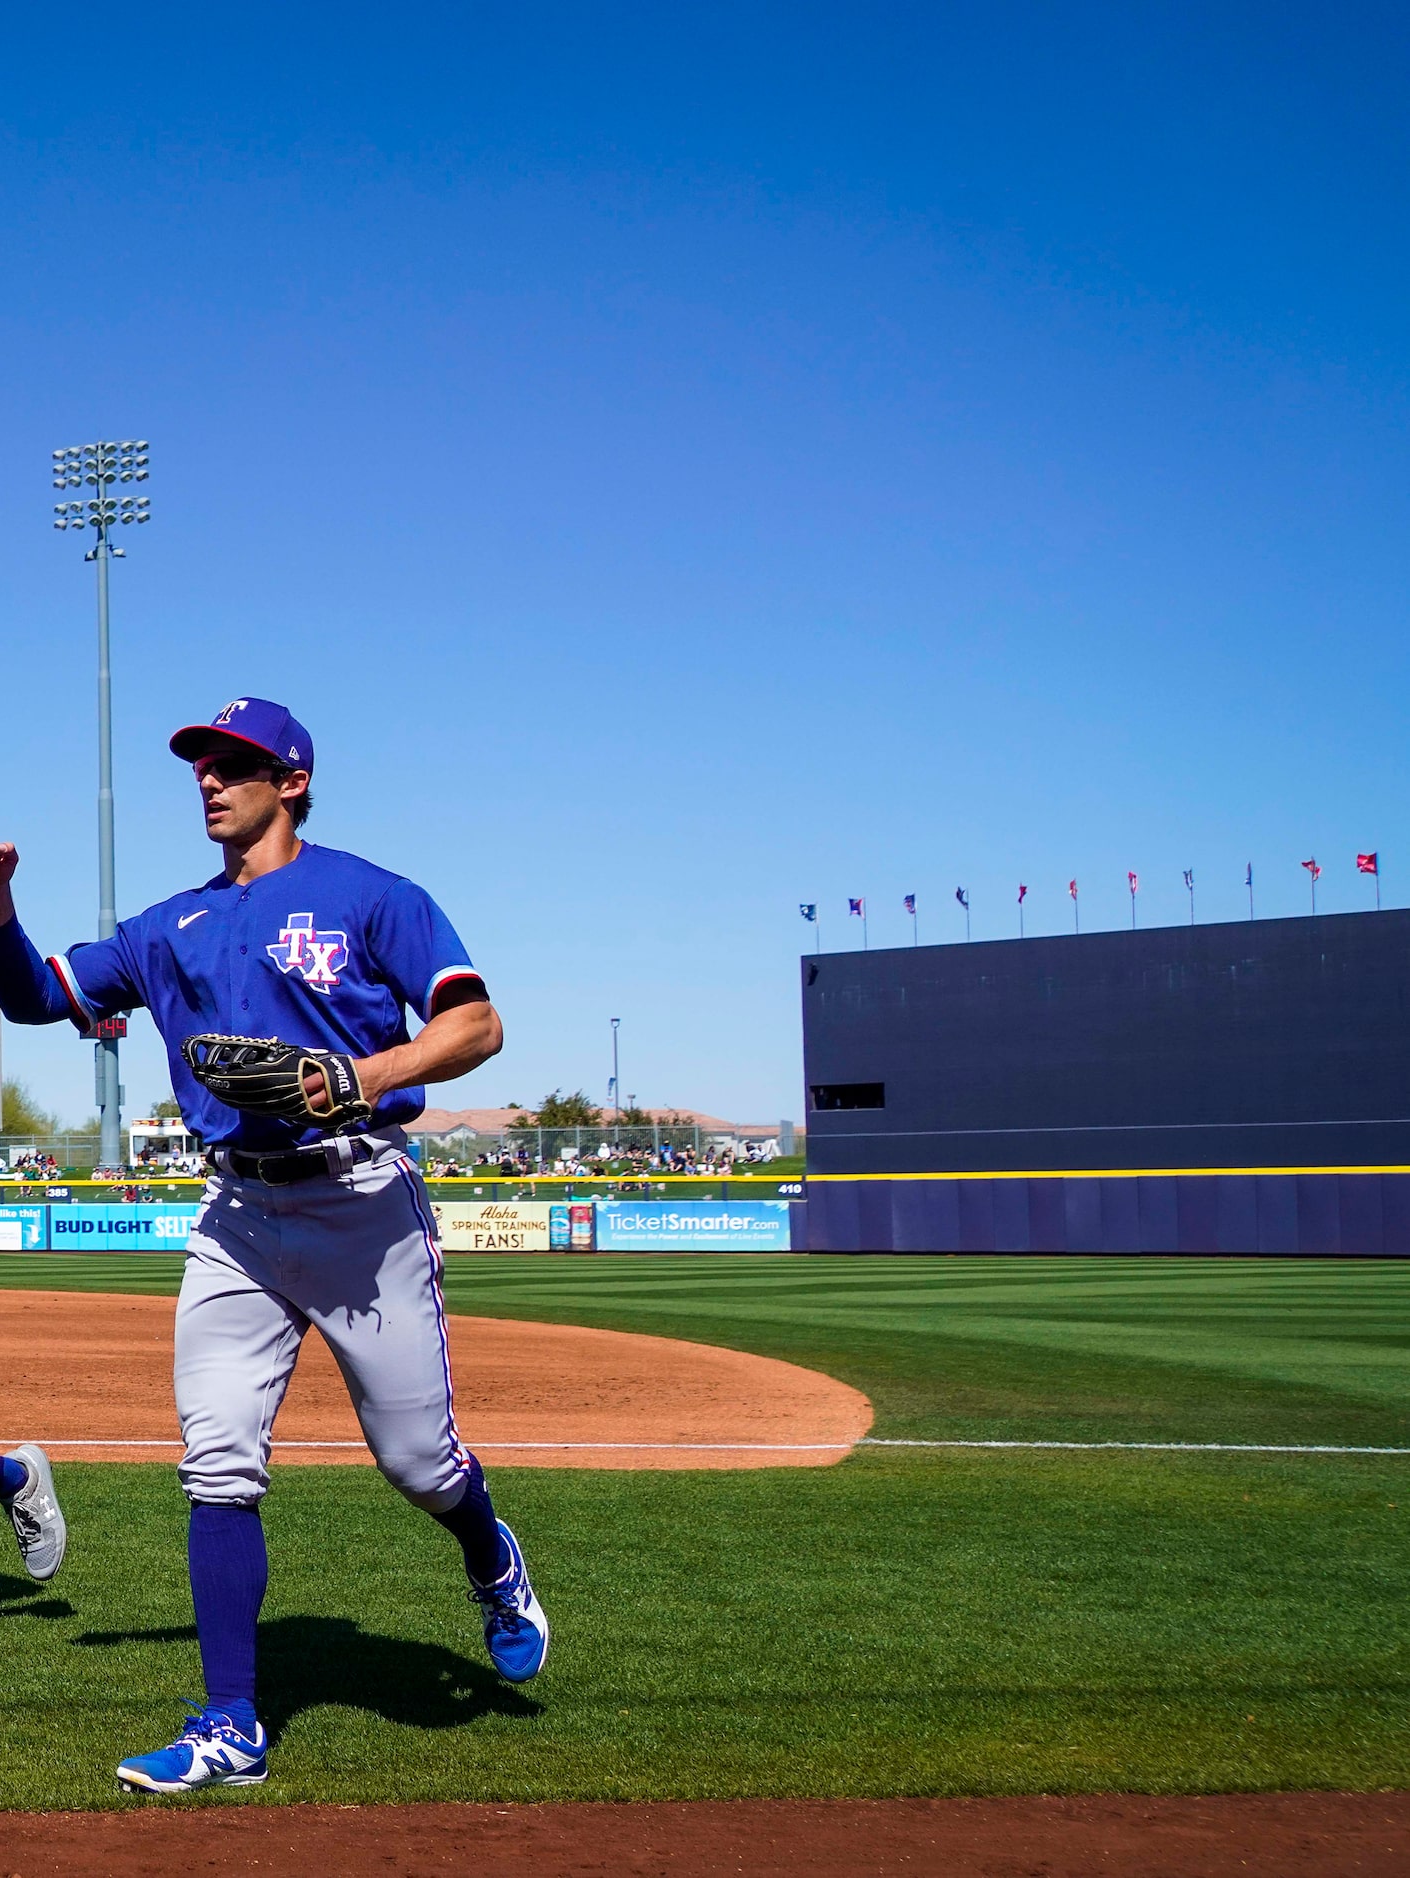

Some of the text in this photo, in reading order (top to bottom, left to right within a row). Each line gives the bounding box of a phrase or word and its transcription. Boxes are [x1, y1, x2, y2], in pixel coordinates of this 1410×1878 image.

[97, 1018, 127, 1038] 1:44
[48, 1188, 68, 1197] 385
[778, 1184, 802, 1194] 410
[0, 1208, 17, 1218] like
[19, 1208, 41, 1218] this!
[480, 1205, 519, 1219] Aloha
[55, 1220, 94, 1234] BUD
[98, 1220, 152, 1234] LIGHT
[451, 1220, 547, 1231] SPRING TRAINING
[475, 1234, 525, 1249] FANS!
